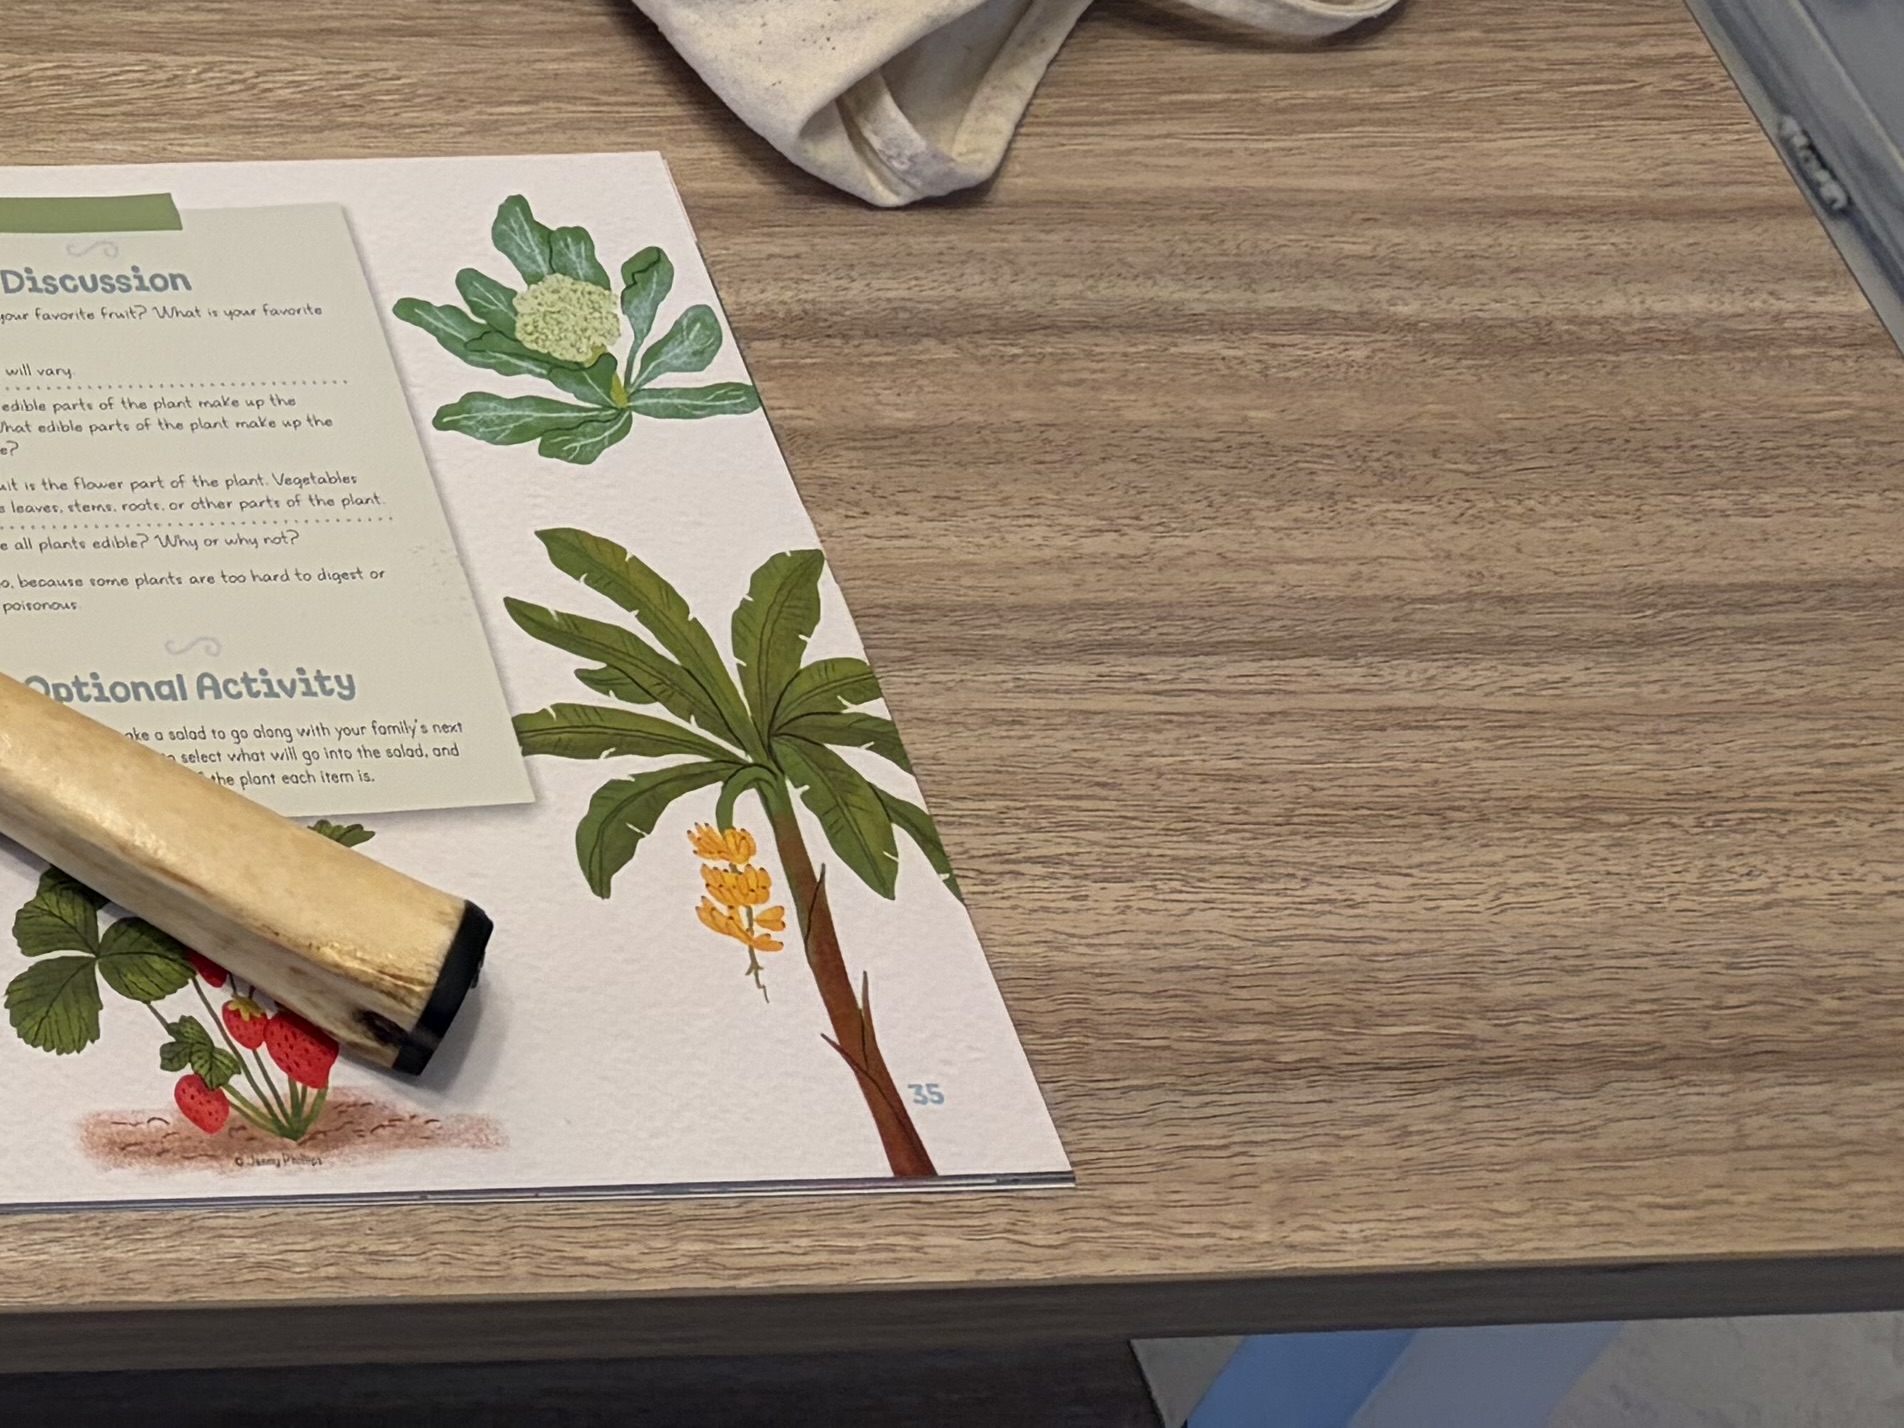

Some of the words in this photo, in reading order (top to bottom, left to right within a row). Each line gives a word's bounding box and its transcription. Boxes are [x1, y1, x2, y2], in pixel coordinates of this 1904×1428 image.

[0, 265, 192, 295] Discussion
[38, 420, 82, 433] edible
[89, 419, 129, 435] parts
[136, 418, 151, 431] of
[158, 418, 183, 430] the
[190, 417, 229, 433] plant
[236, 416, 276, 428] make
[282, 419, 302, 430] up
[307, 414, 332, 427] the
[15, 537, 32, 550] all
[39, 536, 85, 553] plants
[93, 533, 149, 549] edible?
[154, 534, 198, 551] Why
[225, 533, 258, 549] why
[264, 529, 299, 545] not?
[197, 669, 355, 701] Activity
[181, 750, 222, 763] select
[227, 748, 265, 762] what
[270, 746, 297, 761] will
[302, 751, 320, 766] go
[323, 747, 352, 759] into
[357, 744, 381, 759] the
[386, 743, 428, 758] salad,
[432, 742, 459, 757] and
[240, 771, 275, 790] plant
[282, 770, 316, 784] each
[320, 771, 354, 783] item
[357, 770, 375, 782] is.
[907, 1082, 946, 1106] 35
